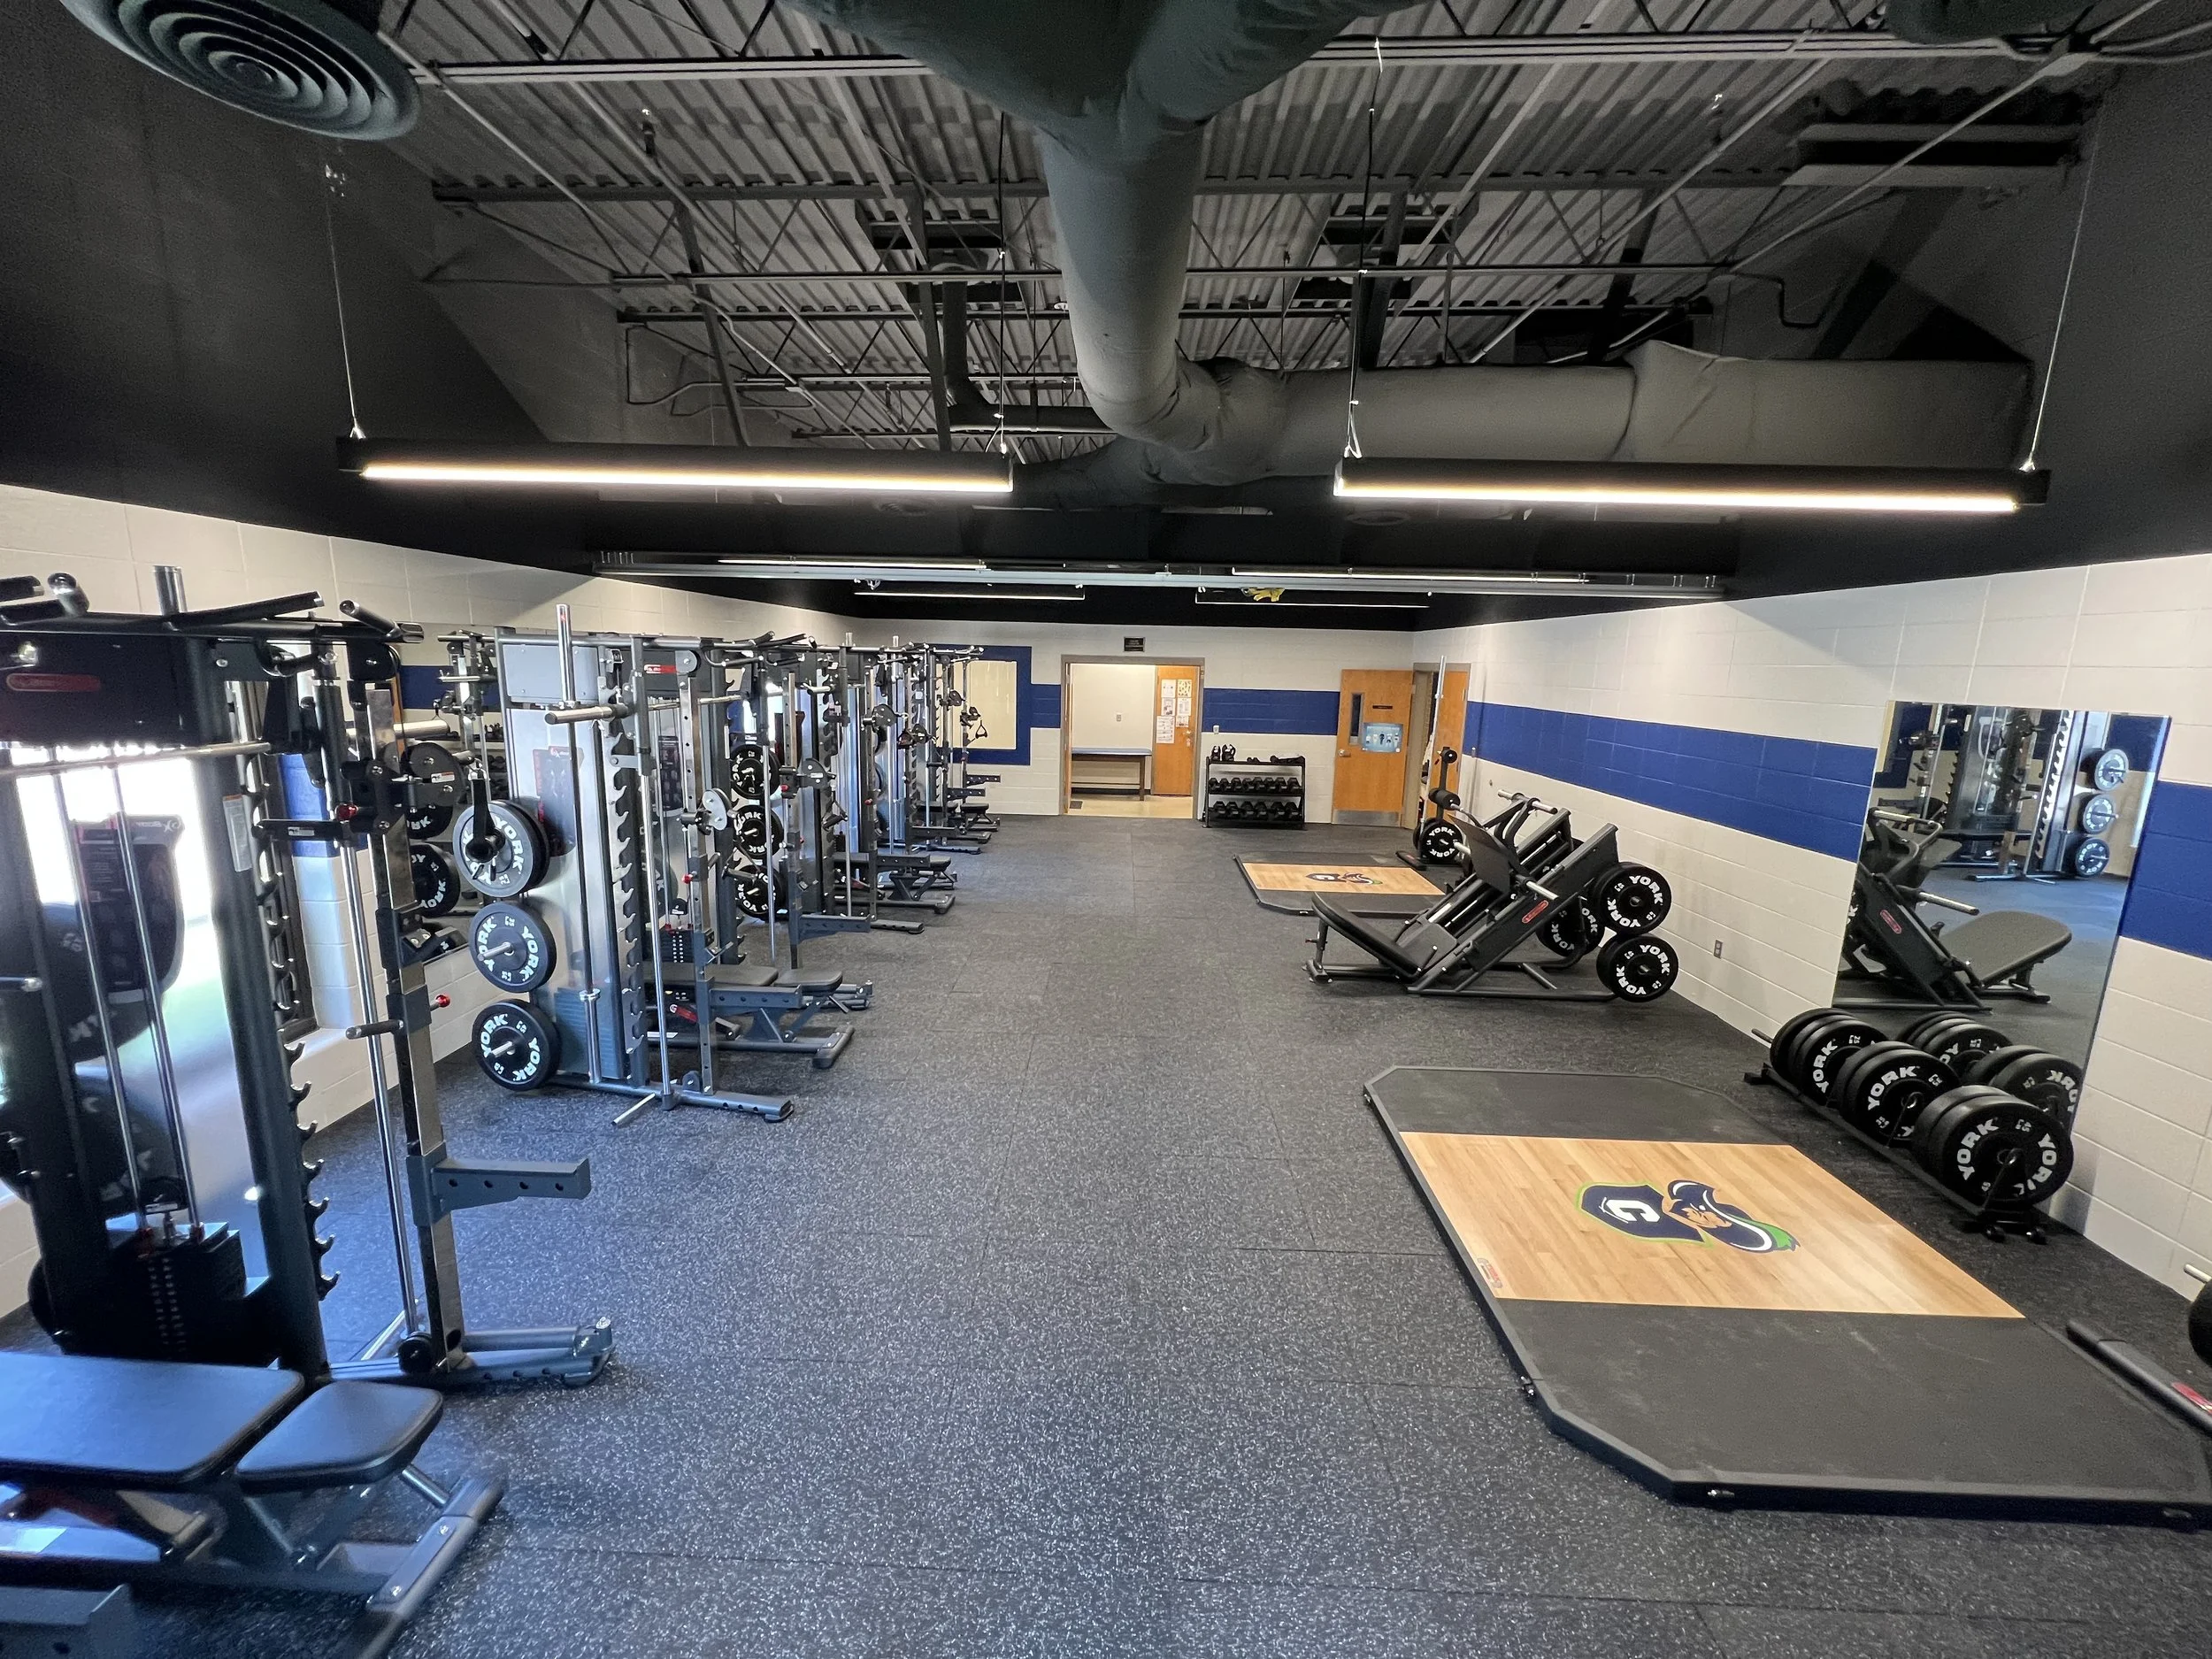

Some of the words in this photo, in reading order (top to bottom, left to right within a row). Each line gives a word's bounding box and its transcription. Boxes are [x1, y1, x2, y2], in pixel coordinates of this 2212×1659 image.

[495, 816, 525, 872] YORK
[1428, 826, 1455, 837] YORK
[1429, 848, 1455, 858] YORK
[737, 884, 757, 912] YORK
[1629, 875, 1663, 904] YORK
[1581, 907, 1598, 933] ORK
[1607, 898, 1641, 928] YORK
[521, 926, 539, 980] YORK
[1640, 945, 1671, 974] YORK
[1616, 965, 1647, 995] YORK
[480, 1014, 509, 1057] YORK
[512, 1037, 540, 1081] YORK
[1813, 1041, 1839, 1094] YORK
[1868, 1066, 1917, 1110] YORK
[1956, 1118, 2000, 1180] YORK
[2013, 1133, 2057, 1195] YORK
